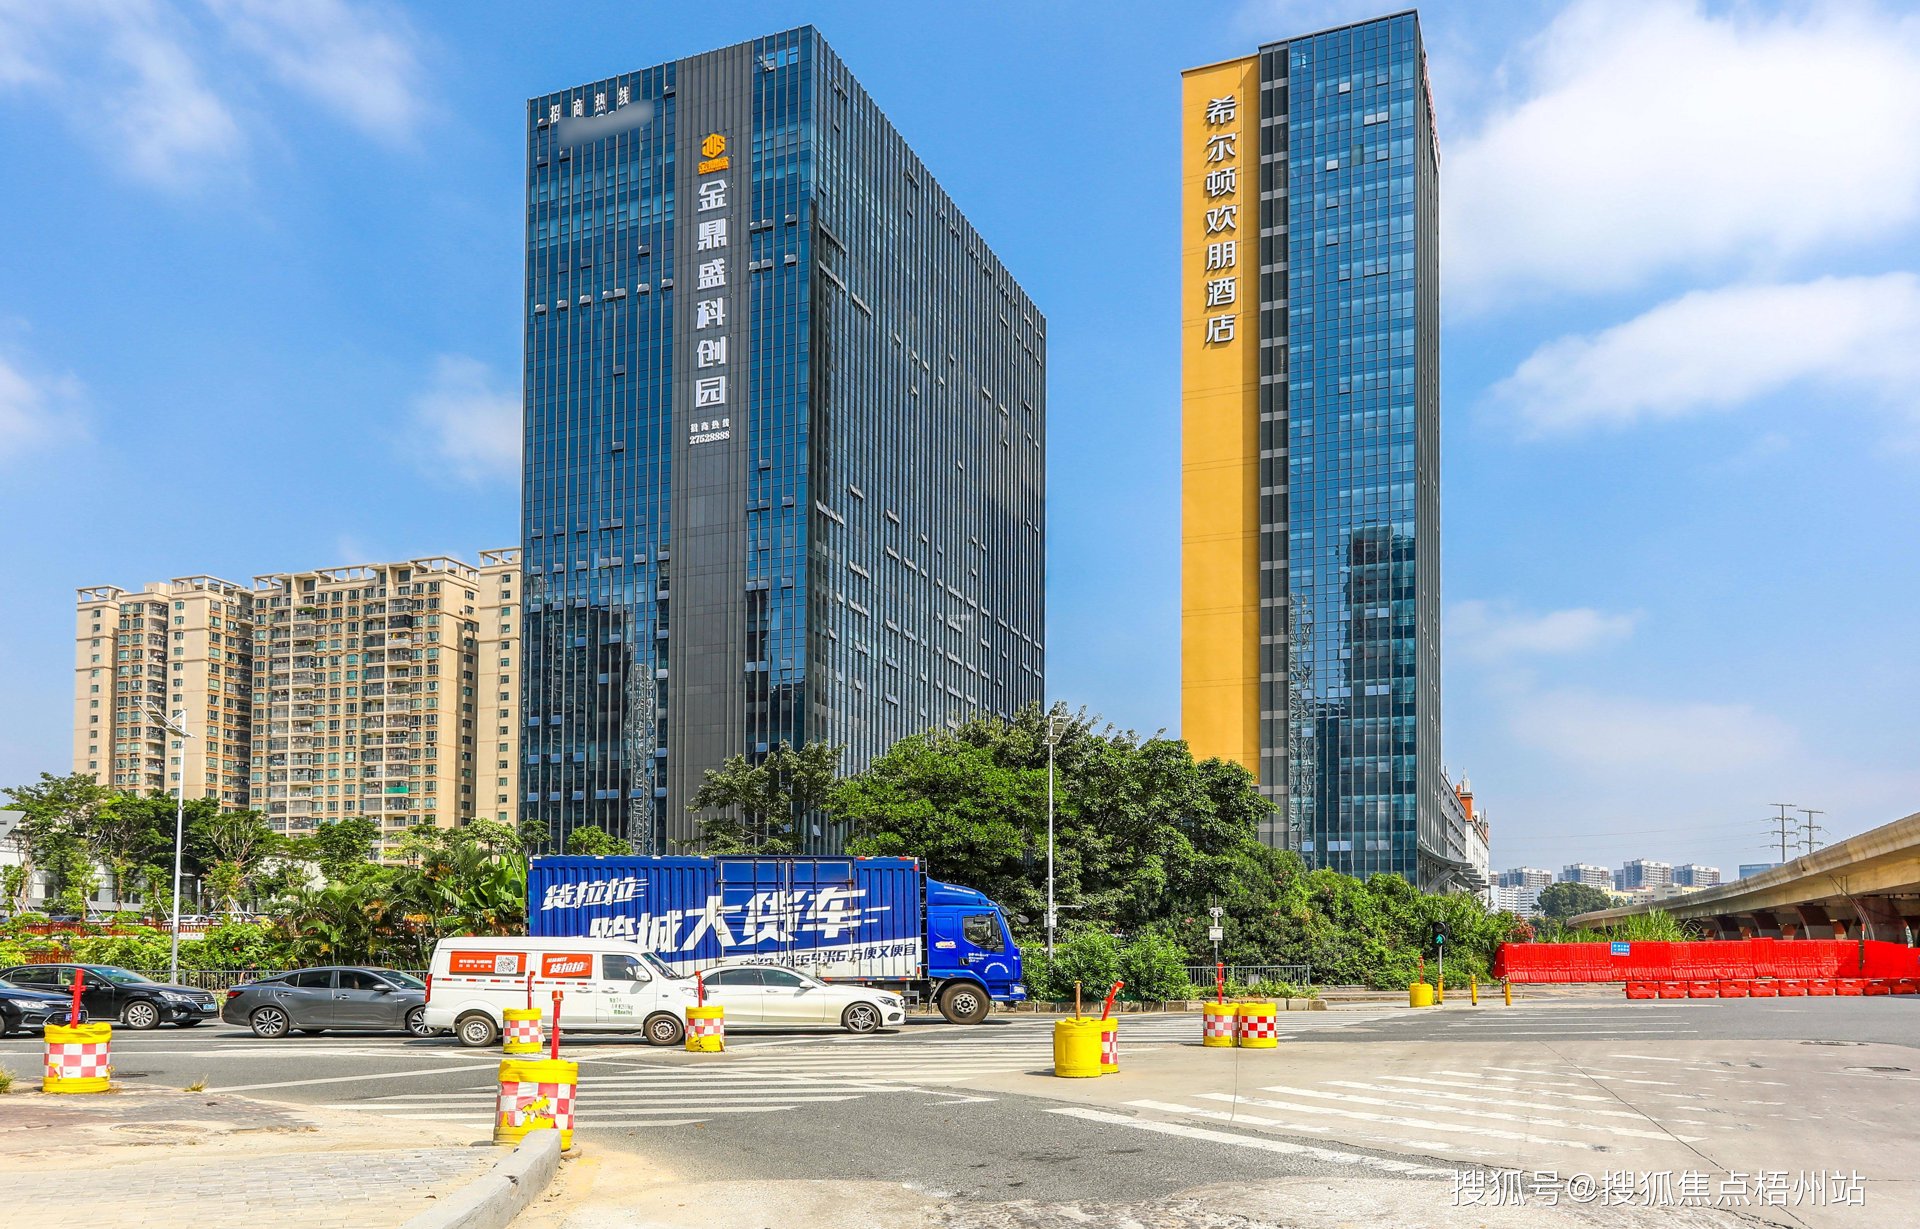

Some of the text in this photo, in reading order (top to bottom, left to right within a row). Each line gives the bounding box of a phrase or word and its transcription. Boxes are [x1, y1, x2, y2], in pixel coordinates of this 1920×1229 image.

[549, 85, 631, 124] 招商热线
[1206, 94, 1237, 344] 希尔顿欢朋酒店
[696, 179, 728, 408] 金鼎盛科创园
[541, 876, 643, 911] 货拉拉
